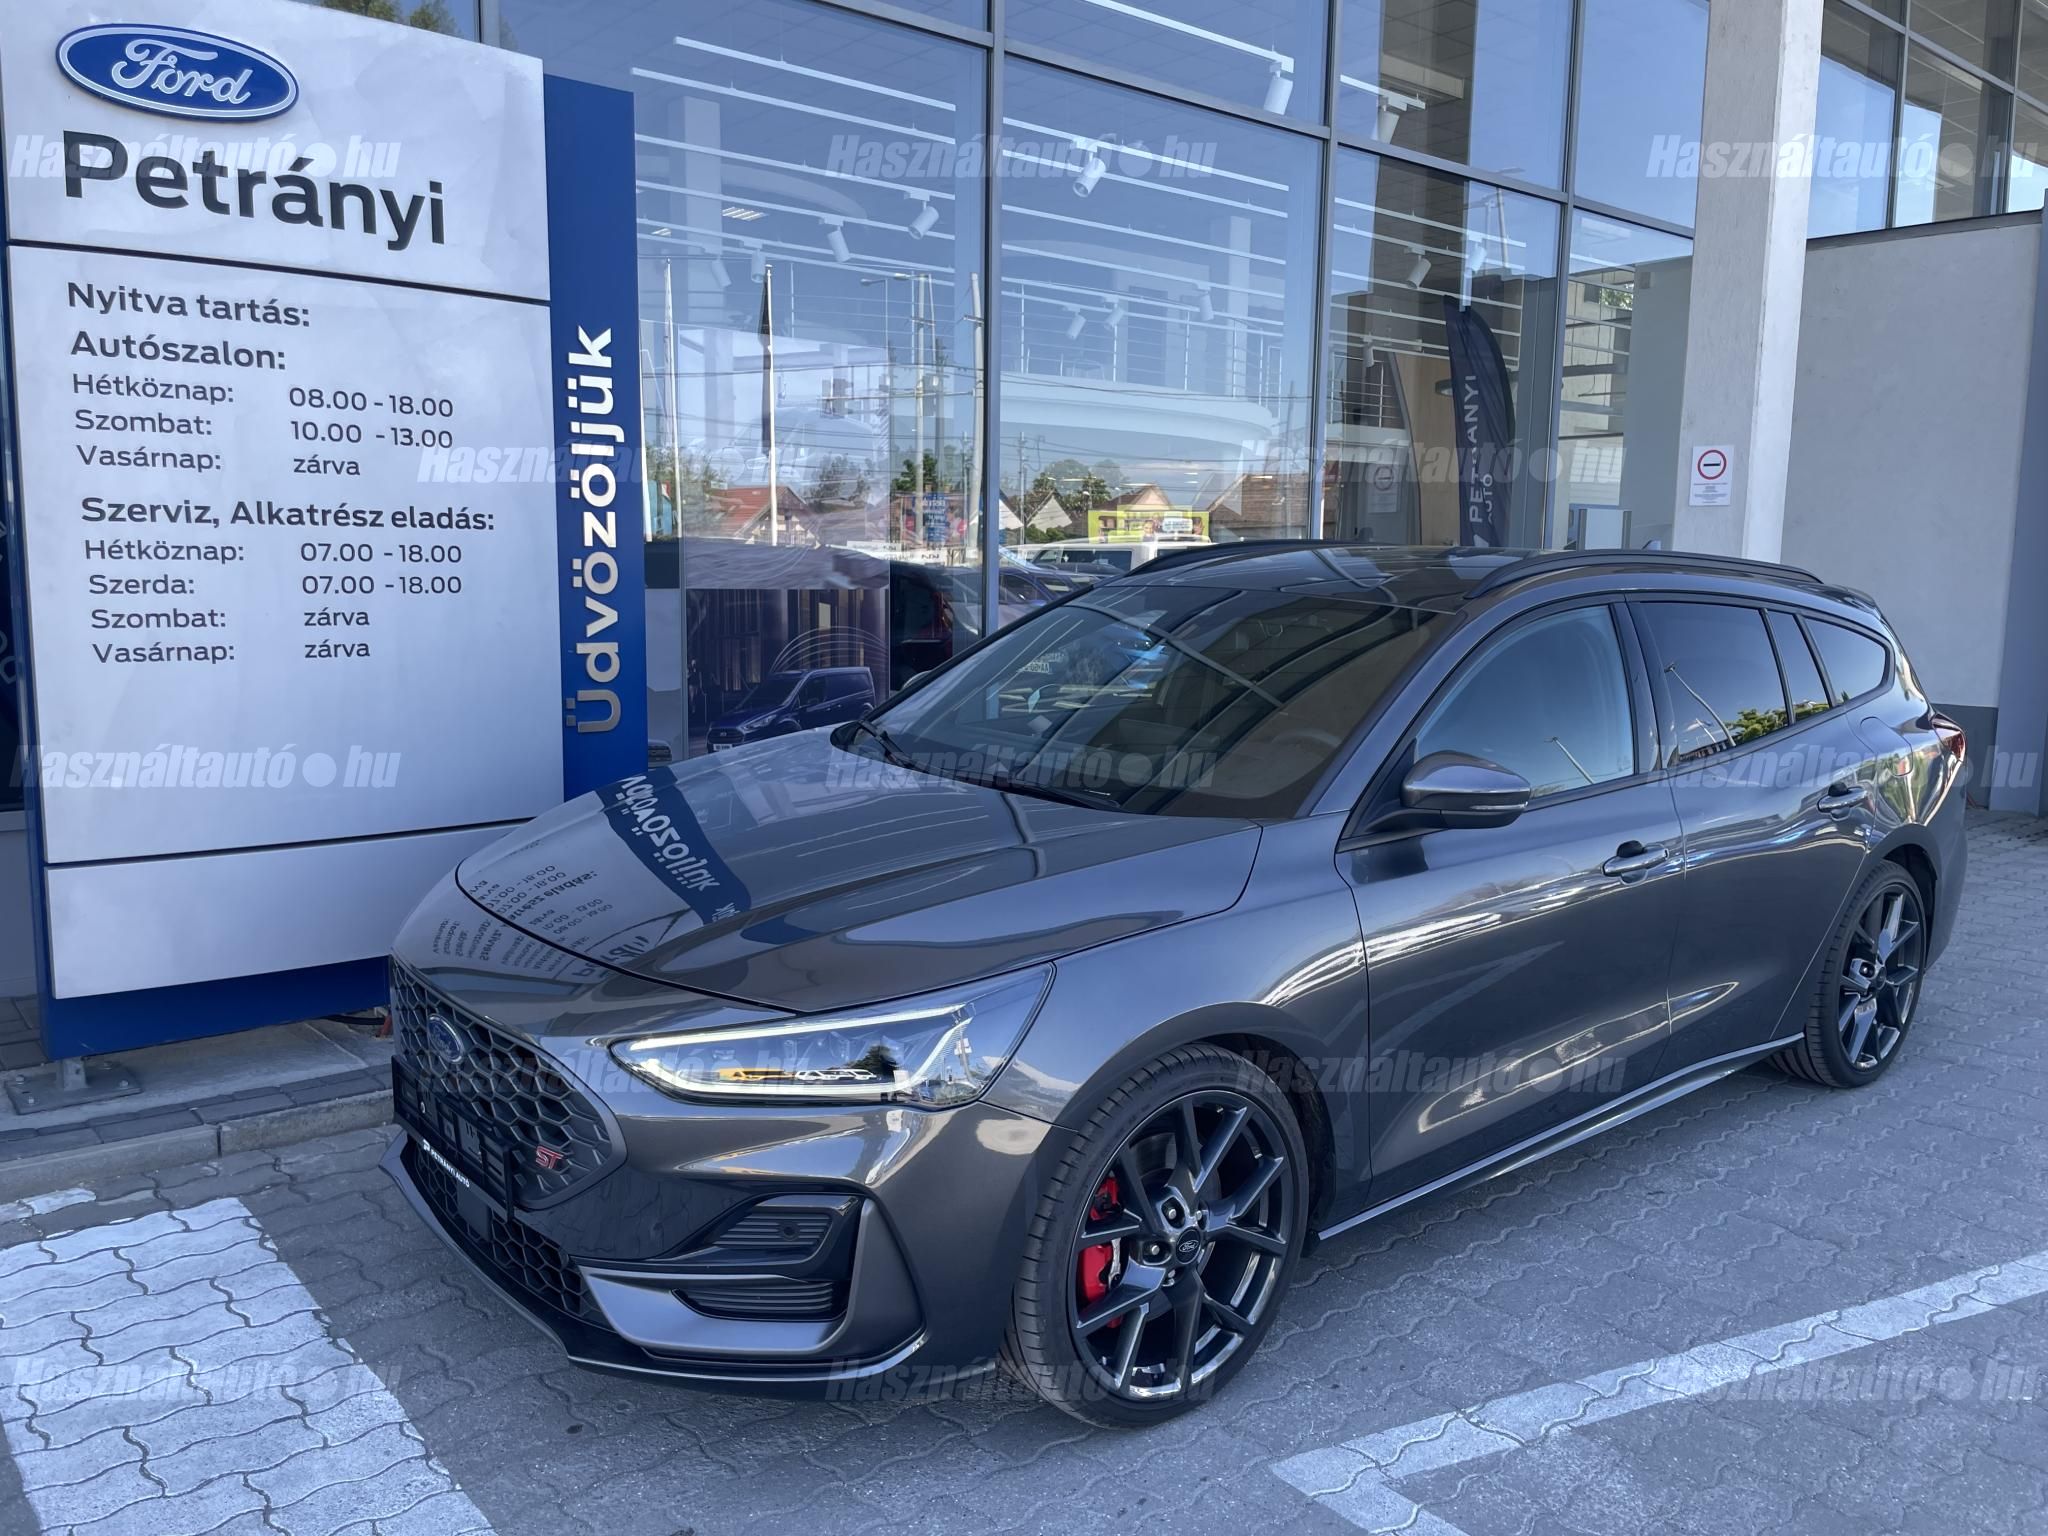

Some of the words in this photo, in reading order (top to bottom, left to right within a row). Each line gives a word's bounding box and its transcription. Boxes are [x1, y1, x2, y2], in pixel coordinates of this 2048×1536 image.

[112, 38, 253, 105] Ford
[63, 130, 445, 251] Petrányi
[67, 282, 189, 317] Nyitva
[195, 295, 310, 328] tartás:
[71, 331, 286, 370] Autószalon:
[73, 374, 234, 405] Hétköznap:
[289, 387, 368, 411] 08.00
[75, 409, 212, 436] Szombat:
[290, 421, 362, 444] 10.00
[76, 445, 221, 473] Vasárnap:
[293, 454, 361, 476] zárva
[81, 497, 220, 528] Szerviz,
[230, 500, 385, 528] Alkatrész
[390, 505, 495, 531] eladás:
[566, 325, 624, 733] Üdvözöljük
[85, 539, 244, 565] Hétköznap:
[300, 542, 374, 563] 07.00
[89, 574, 195, 595] Szerda:
[302, 575, 375, 594] 07.00
[92, 607, 226, 629] Szombat:
[303, 607, 371, 627] zárva
[92, 641, 235, 665] Vasárnap:
[304, 638, 371, 659] zárva
[535, 1145, 565, 1170] ST
